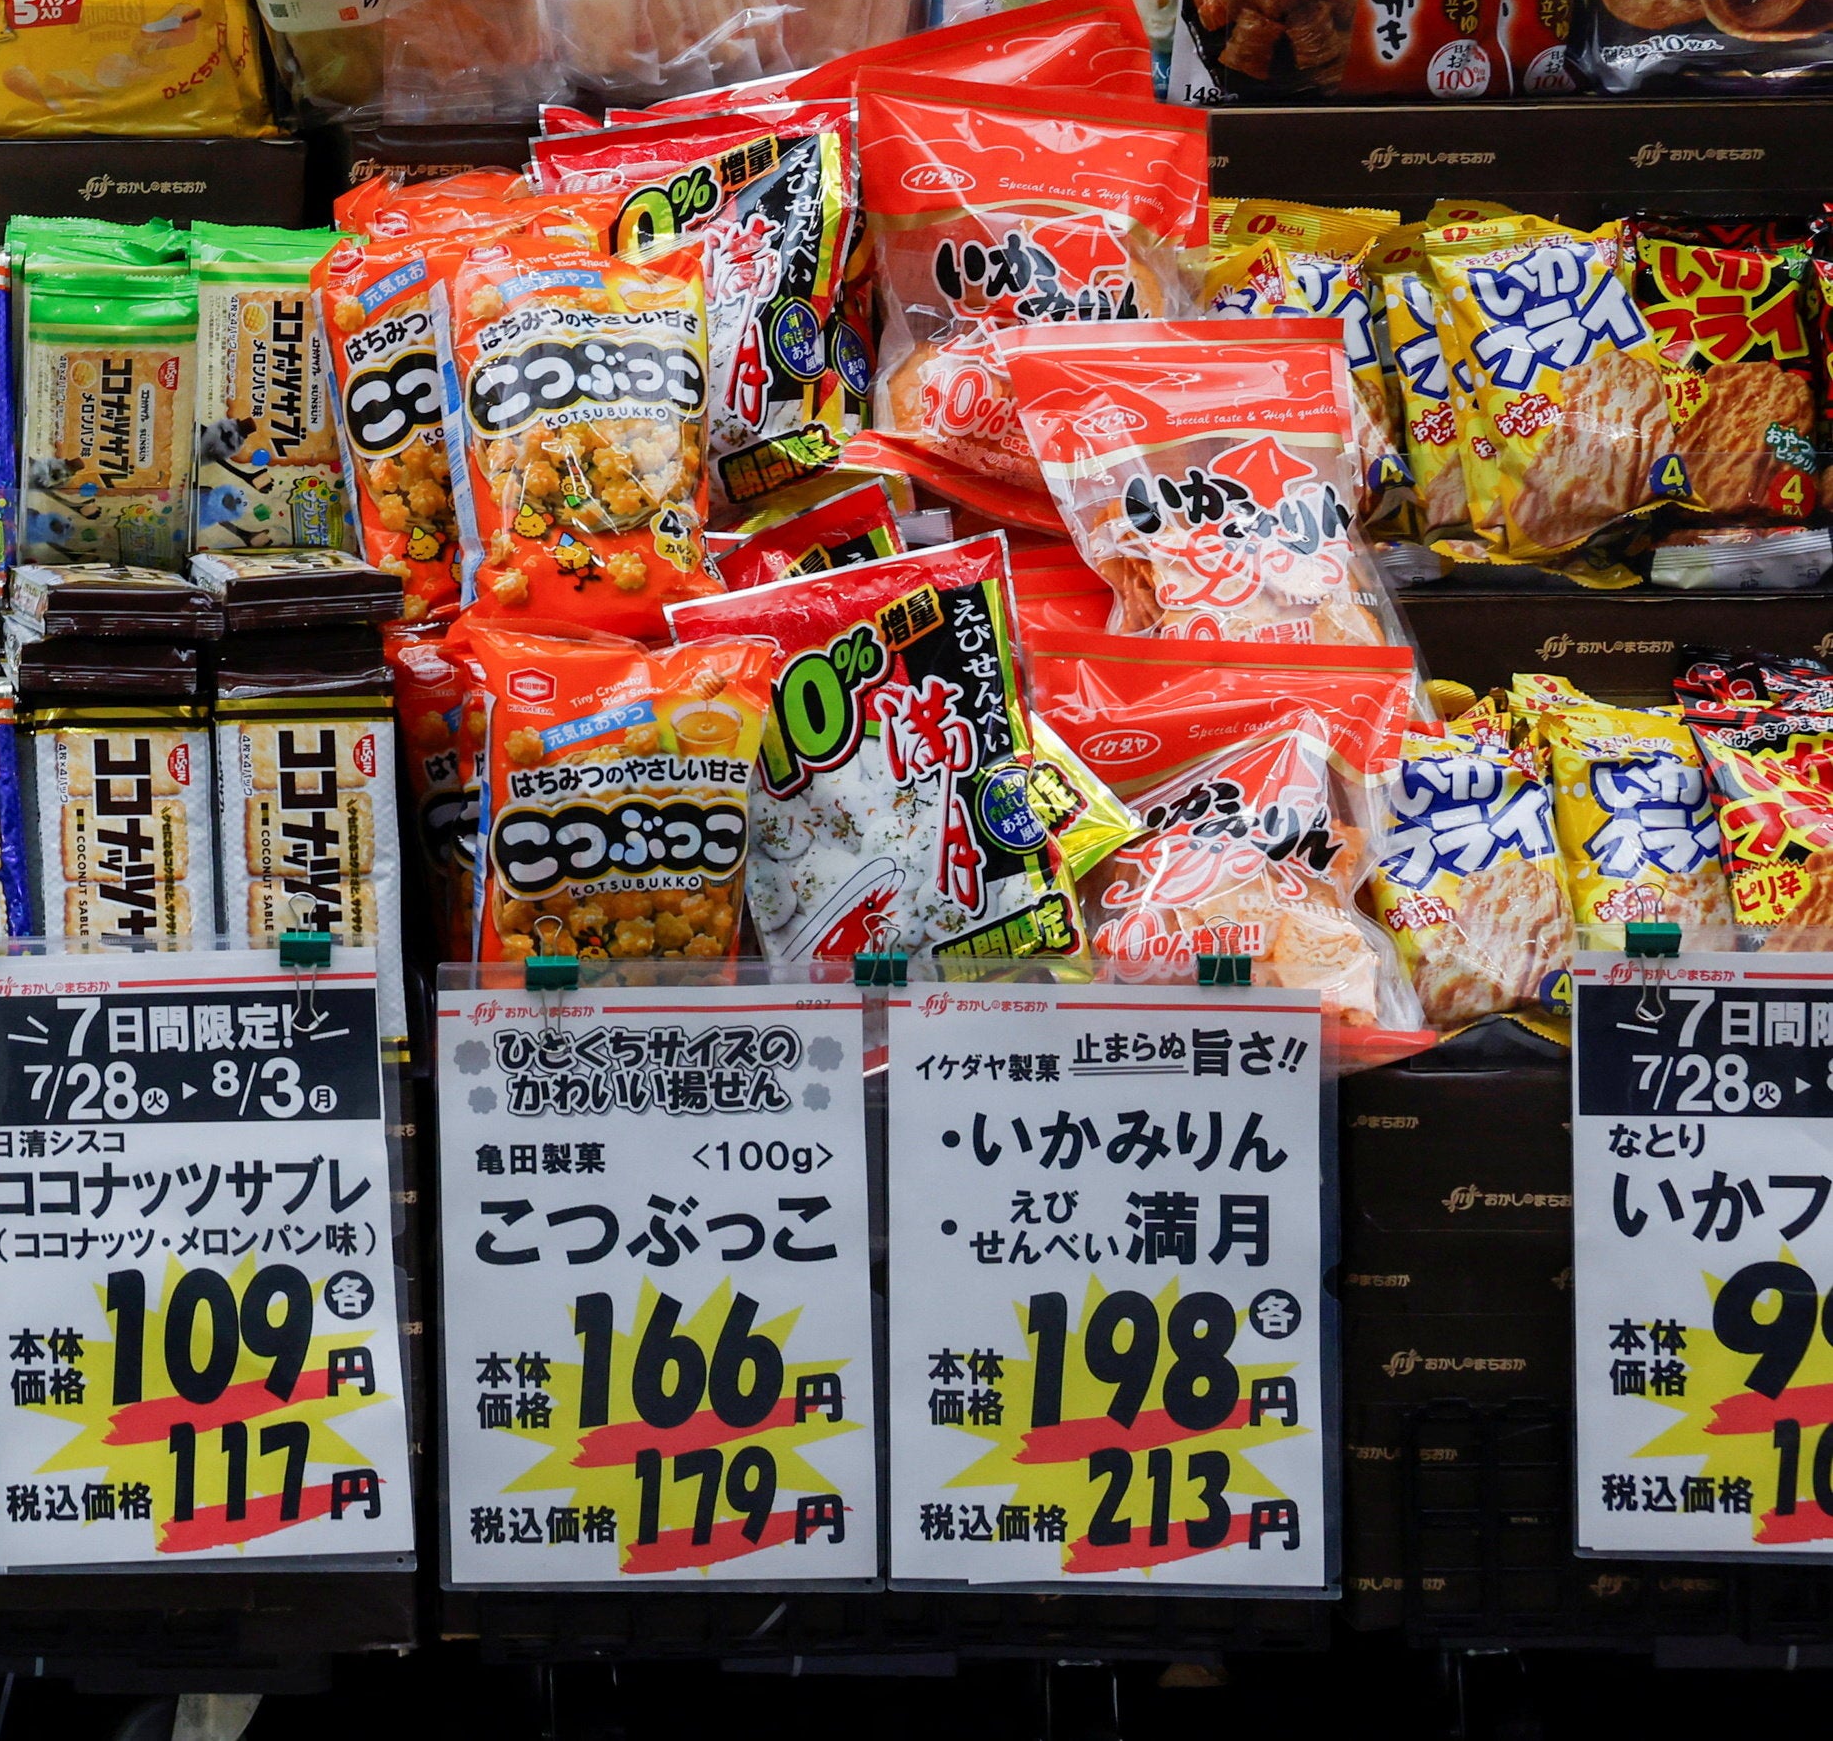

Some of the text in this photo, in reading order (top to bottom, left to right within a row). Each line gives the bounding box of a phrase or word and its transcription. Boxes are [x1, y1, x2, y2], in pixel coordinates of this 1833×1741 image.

[545, 408, 666, 428] KOTSUBUKKO
[954, 599, 1011, 752] えびせんべい
[1091, 738, 1148, 756] イケダヤ
[510, 754, 748, 793] はちみつのやさしい甘さ
[494, 801, 744, 880] こつぶっこ
[76, 833, 90, 893] COCONUT
[54, 995, 294, 1057] 7日間限定!
[494, 1026, 800, 1075] ひとくちサイズの
[916, 1054, 1060, 1082] イケダヤ製菓
[511, 1072, 790, 1116] かわいい揚せん
[475, 1142, 607, 1175] 亀田製菓
[1608, 1124, 1706, 1157] なとり
[1009, 1189, 1078, 1225] えび
[475, 1195, 838, 1267] こつぶっこ
[970, 1191, 1270, 1268] せんべい 満月
